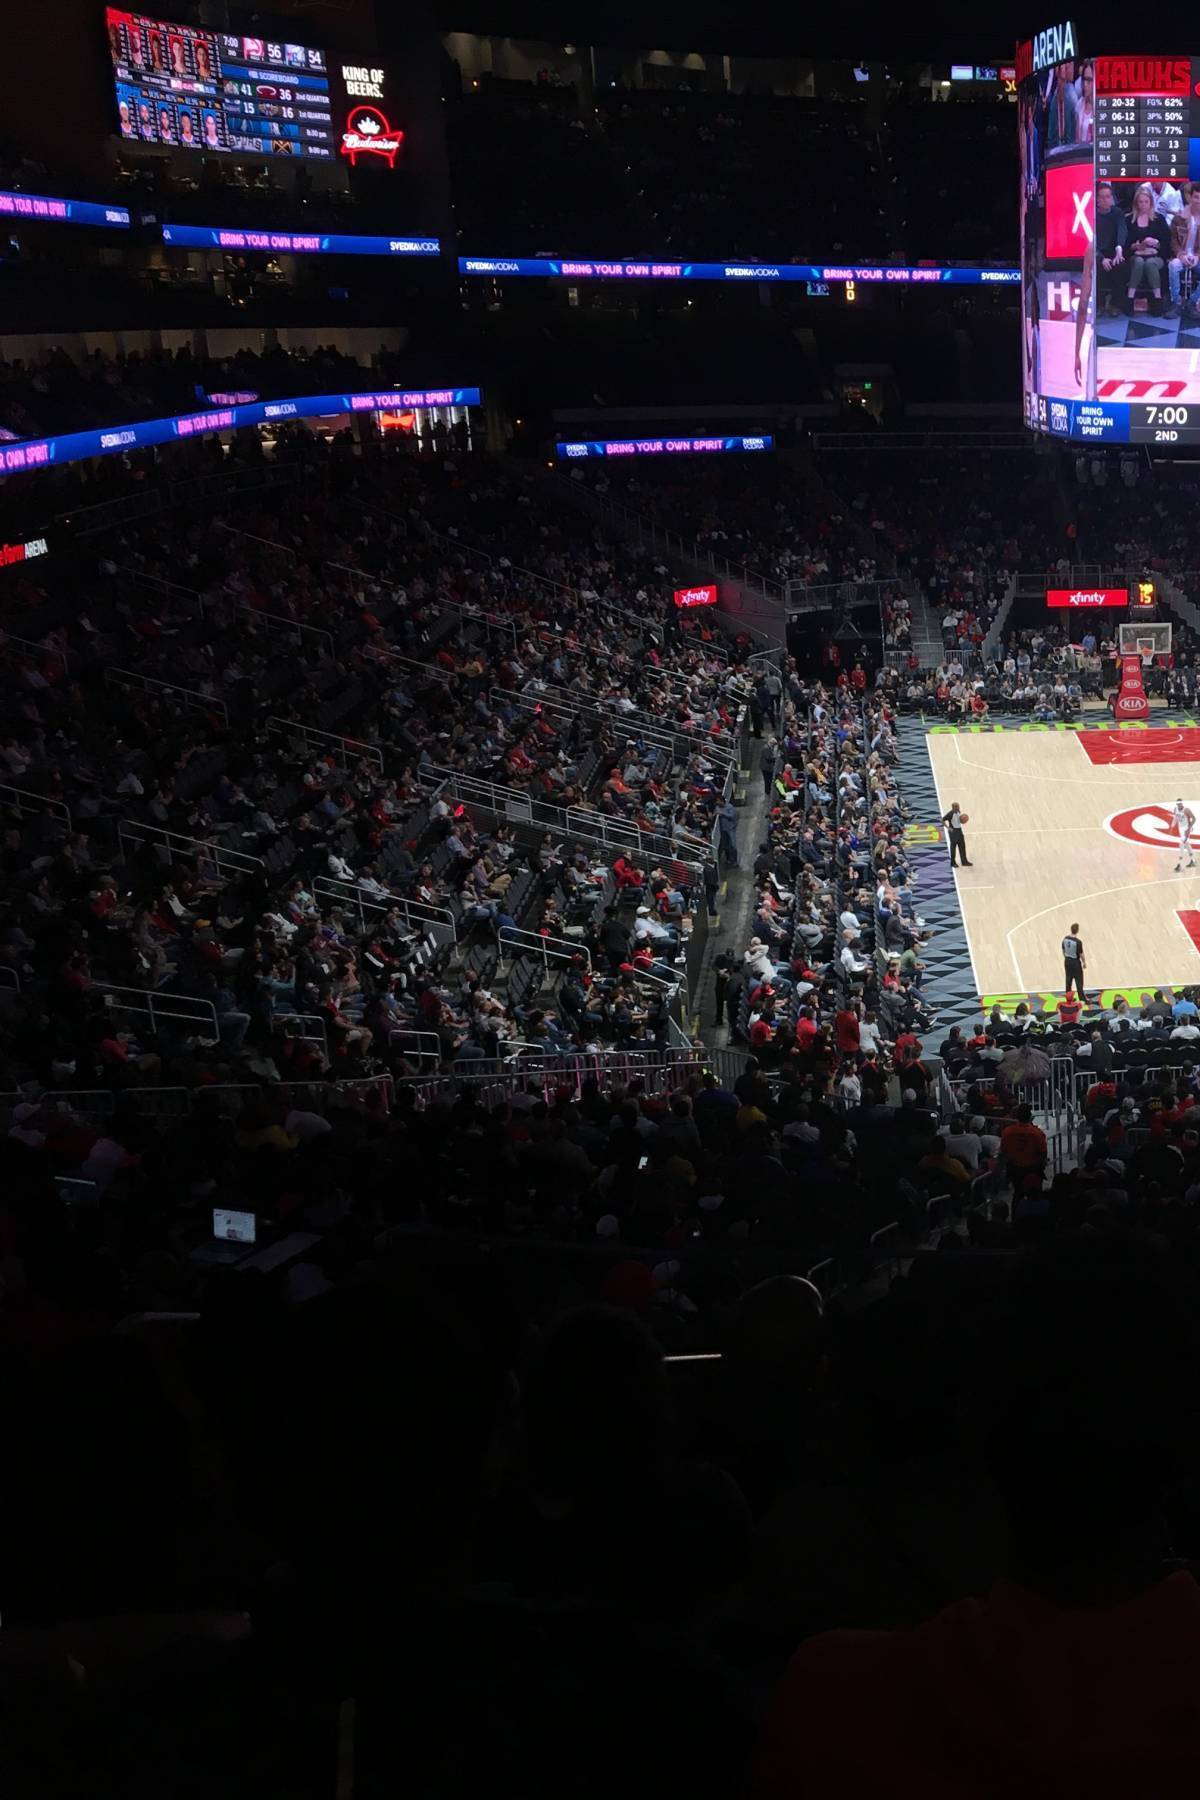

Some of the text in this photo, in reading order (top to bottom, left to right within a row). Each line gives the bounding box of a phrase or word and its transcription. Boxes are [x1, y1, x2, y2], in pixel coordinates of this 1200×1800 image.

[268, 45, 281, 58] 56
[1033, 21, 1074, 71] ARENA
[308, 50, 321, 64] 54
[342, 66, 384, 83] KING OF
[1096, 62, 1190, 88] HAWKS
[241, 84, 252, 96] 41
[280, 89, 291, 100] 36
[346, 81, 384, 98] BEERS.
[244, 103, 255, 113] 15
[282, 107, 294, 118] 16
[220, 233, 319, 249] BRING YOUR OWN SPIRIT
[562, 264, 592, 274] BRING
[594, 265, 622, 275] YOUR
[626, 265, 648, 275] OWN
[652, 266, 681, 276] SPIRIT
[824, 269, 852, 278] BRING
[855, 270, 883, 279] YOUR
[886, 270, 908, 279] OWN
[912, 270, 942, 280] SPIRIT
[352, 392, 453, 409] BRING YOUR OWN SPIRIT
[1051, 403, 1067, 417] SVEDKA
[1082, 407, 1102, 416] BRING
[1146, 407, 1187, 424] 7:00
[1052, 417, 1068, 432] VODKA
[1076, 416, 1113, 426] YOUR OWN
[1082, 427, 1102, 435] SPIRIT
[1155, 431, 1177, 441] 2ND
[606, 440, 723, 454] BRING YOUR OWN SPIRIT
[25, 538, 48, 559] ARENA
[682, 590, 710, 604] xfinity
[1070, 592, 1105, 605] xfinity
[1123, 700, 1142, 708] KIA
